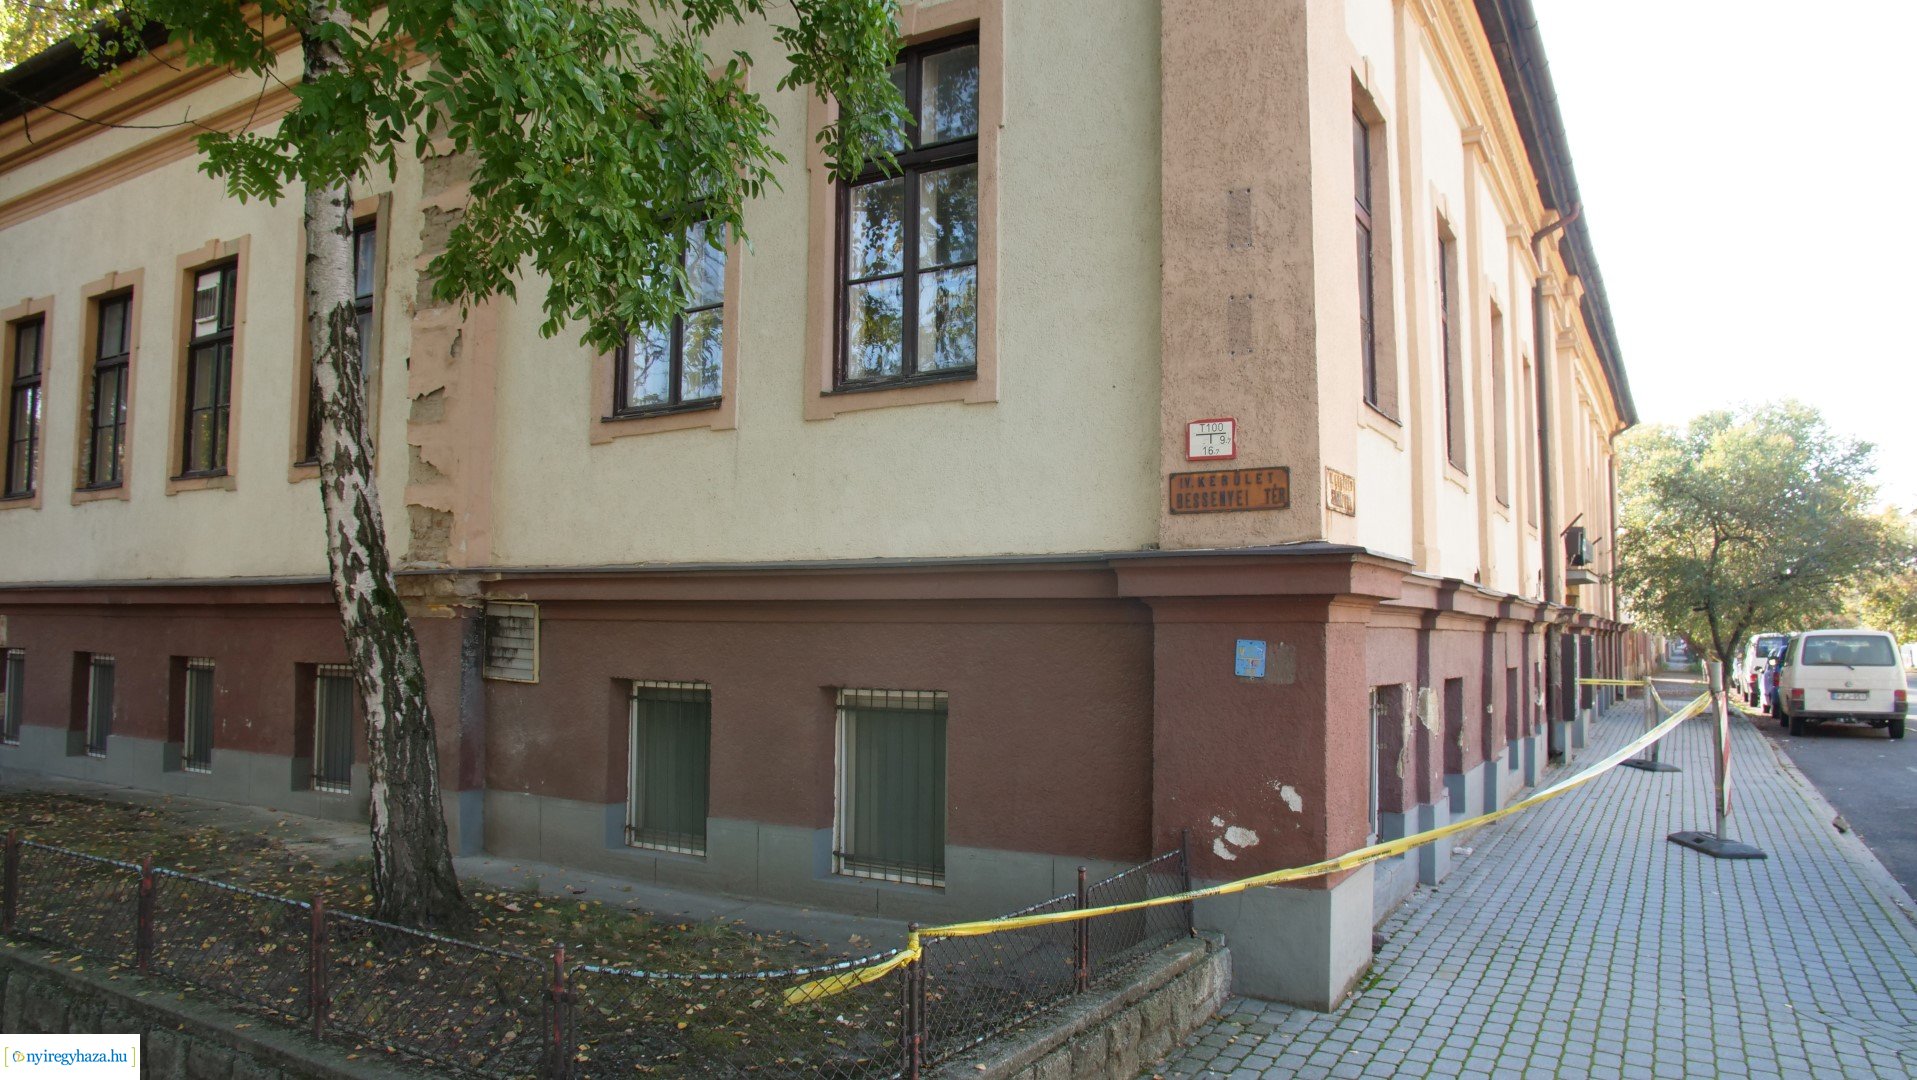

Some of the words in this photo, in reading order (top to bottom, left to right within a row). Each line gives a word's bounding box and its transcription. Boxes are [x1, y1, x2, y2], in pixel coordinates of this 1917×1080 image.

[1200, 423, 1223, 432] T100
[1176, 490, 1249, 508] BESSENYEI
[1264, 483, 1284, 504] TÉR
